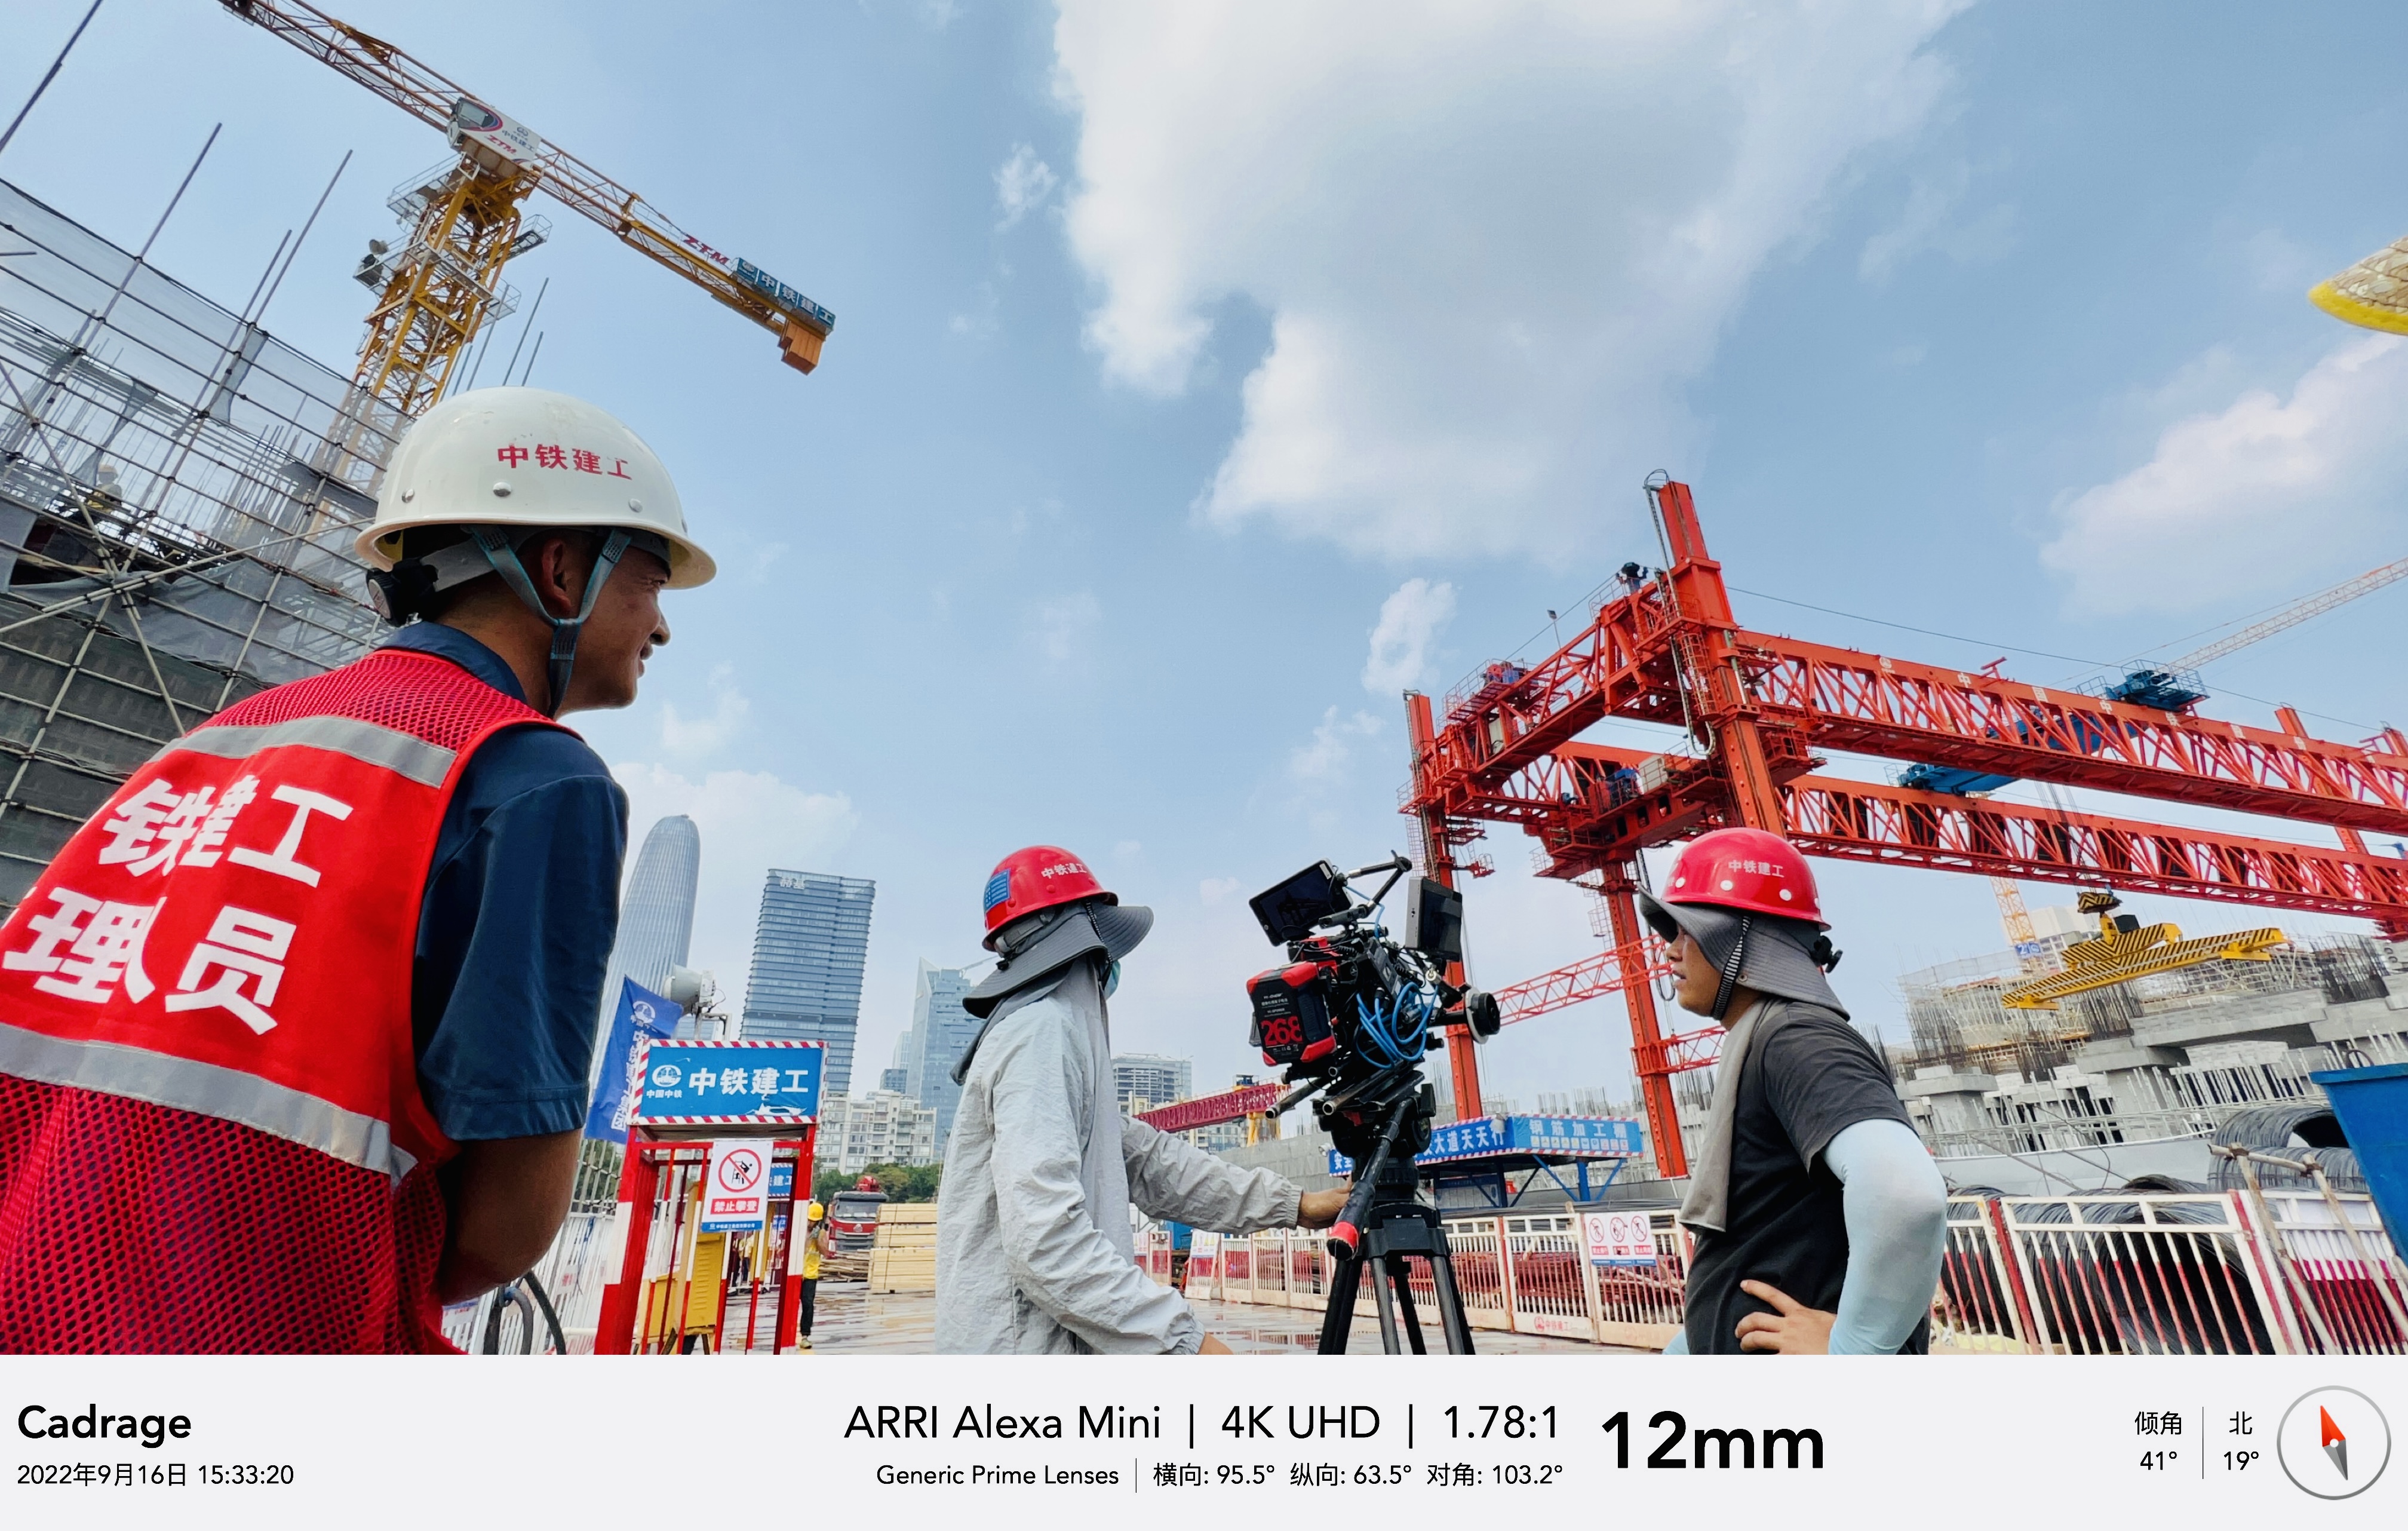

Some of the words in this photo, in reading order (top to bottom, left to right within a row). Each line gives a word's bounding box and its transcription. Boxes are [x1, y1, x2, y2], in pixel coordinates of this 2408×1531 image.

[761, 274, 833, 324] 中铁建工
[497, 444, 632, 480] 中铁建工
[78, 774, 354, 888] 铁建工
[1041, 863, 1087, 879] 中铁建工
[1728, 859, 1784, 878] 中铁建工
[0, 886, 297, 1035] 理人员
[1261, 1016, 1303, 1045] 268
[646, 1090, 683, 1099] 中国中铁
[689, 1067, 809, 1096] 中铁建工
[1415, 1125, 1504, 1158] 大道天天行
[769, 1174, 792, 1186] 建工
